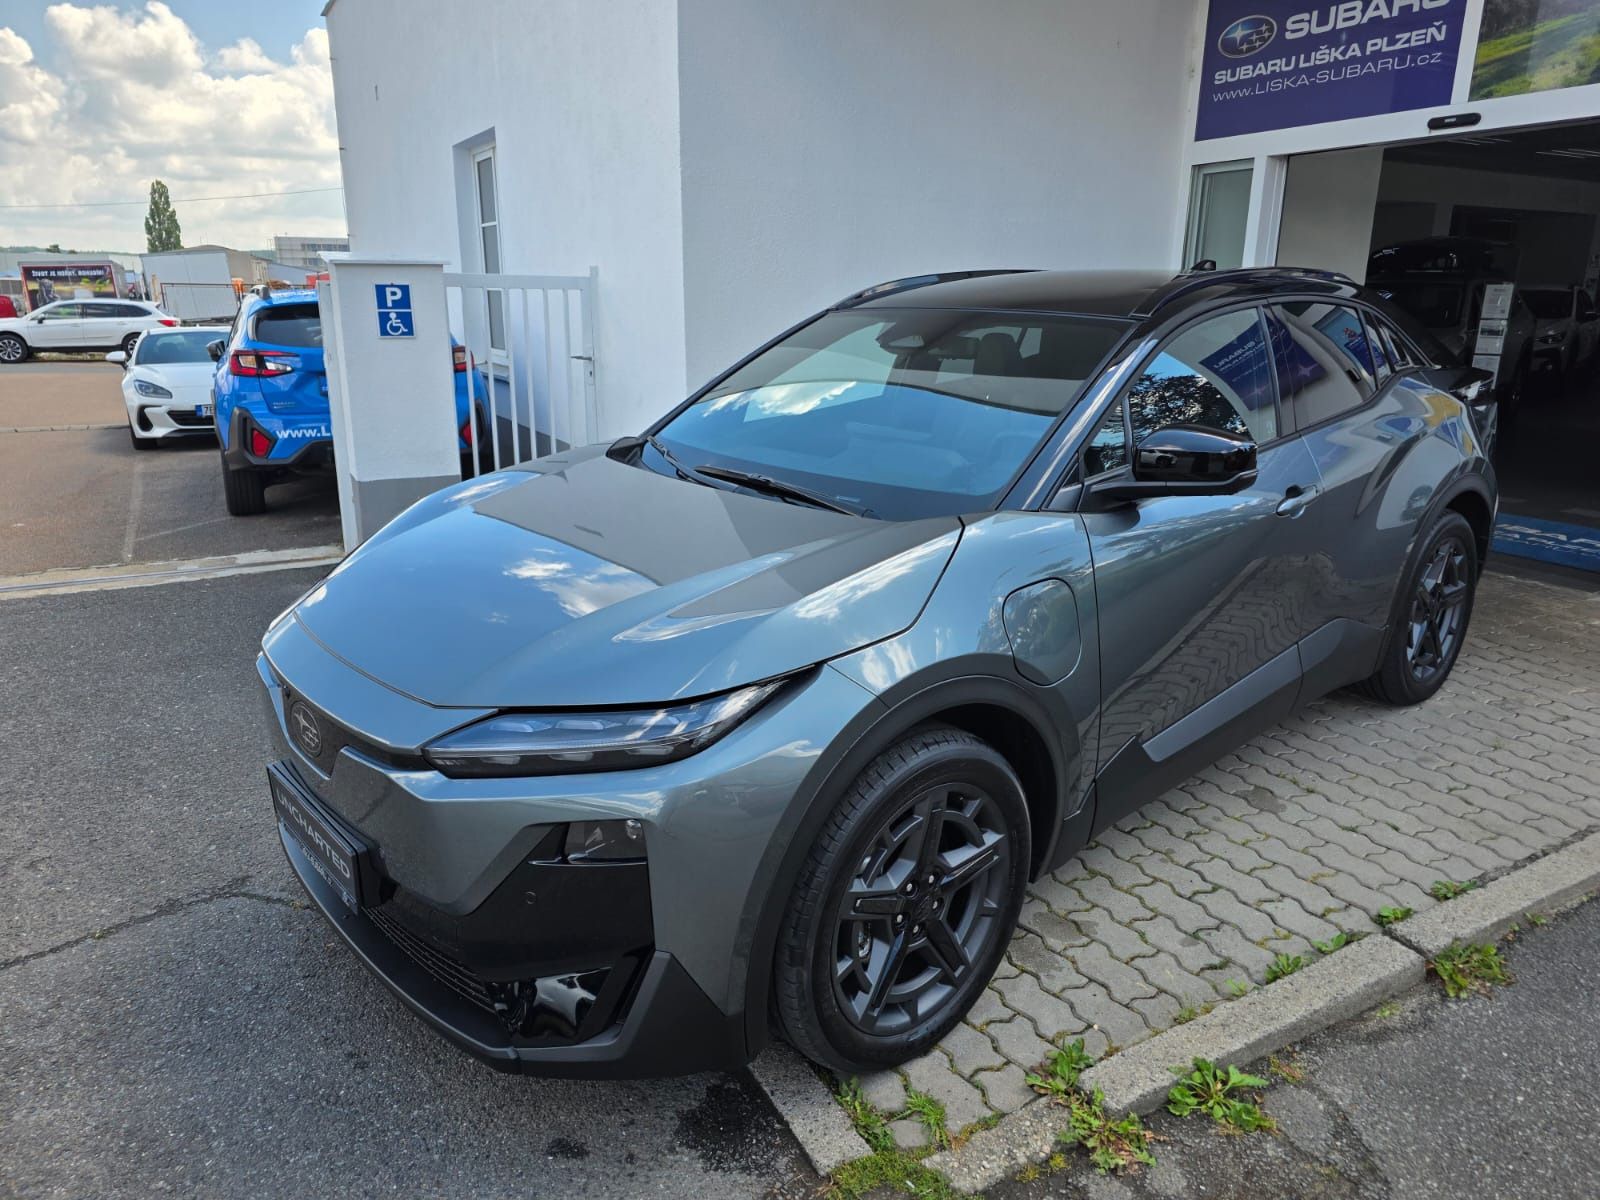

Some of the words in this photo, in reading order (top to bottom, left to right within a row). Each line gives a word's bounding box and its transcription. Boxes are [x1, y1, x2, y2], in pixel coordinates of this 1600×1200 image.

[1213, 52, 1442, 102] www.LISKA-SUBARU.cz
[1214, 55, 1296, 85] SUBARU
[1299, 45, 1361, 68] LIŠKA
[1366, 21, 1447, 55] PLZEŇ
[385, 287, 402, 307] P
[276, 788, 351, 879] UNCHARTED
